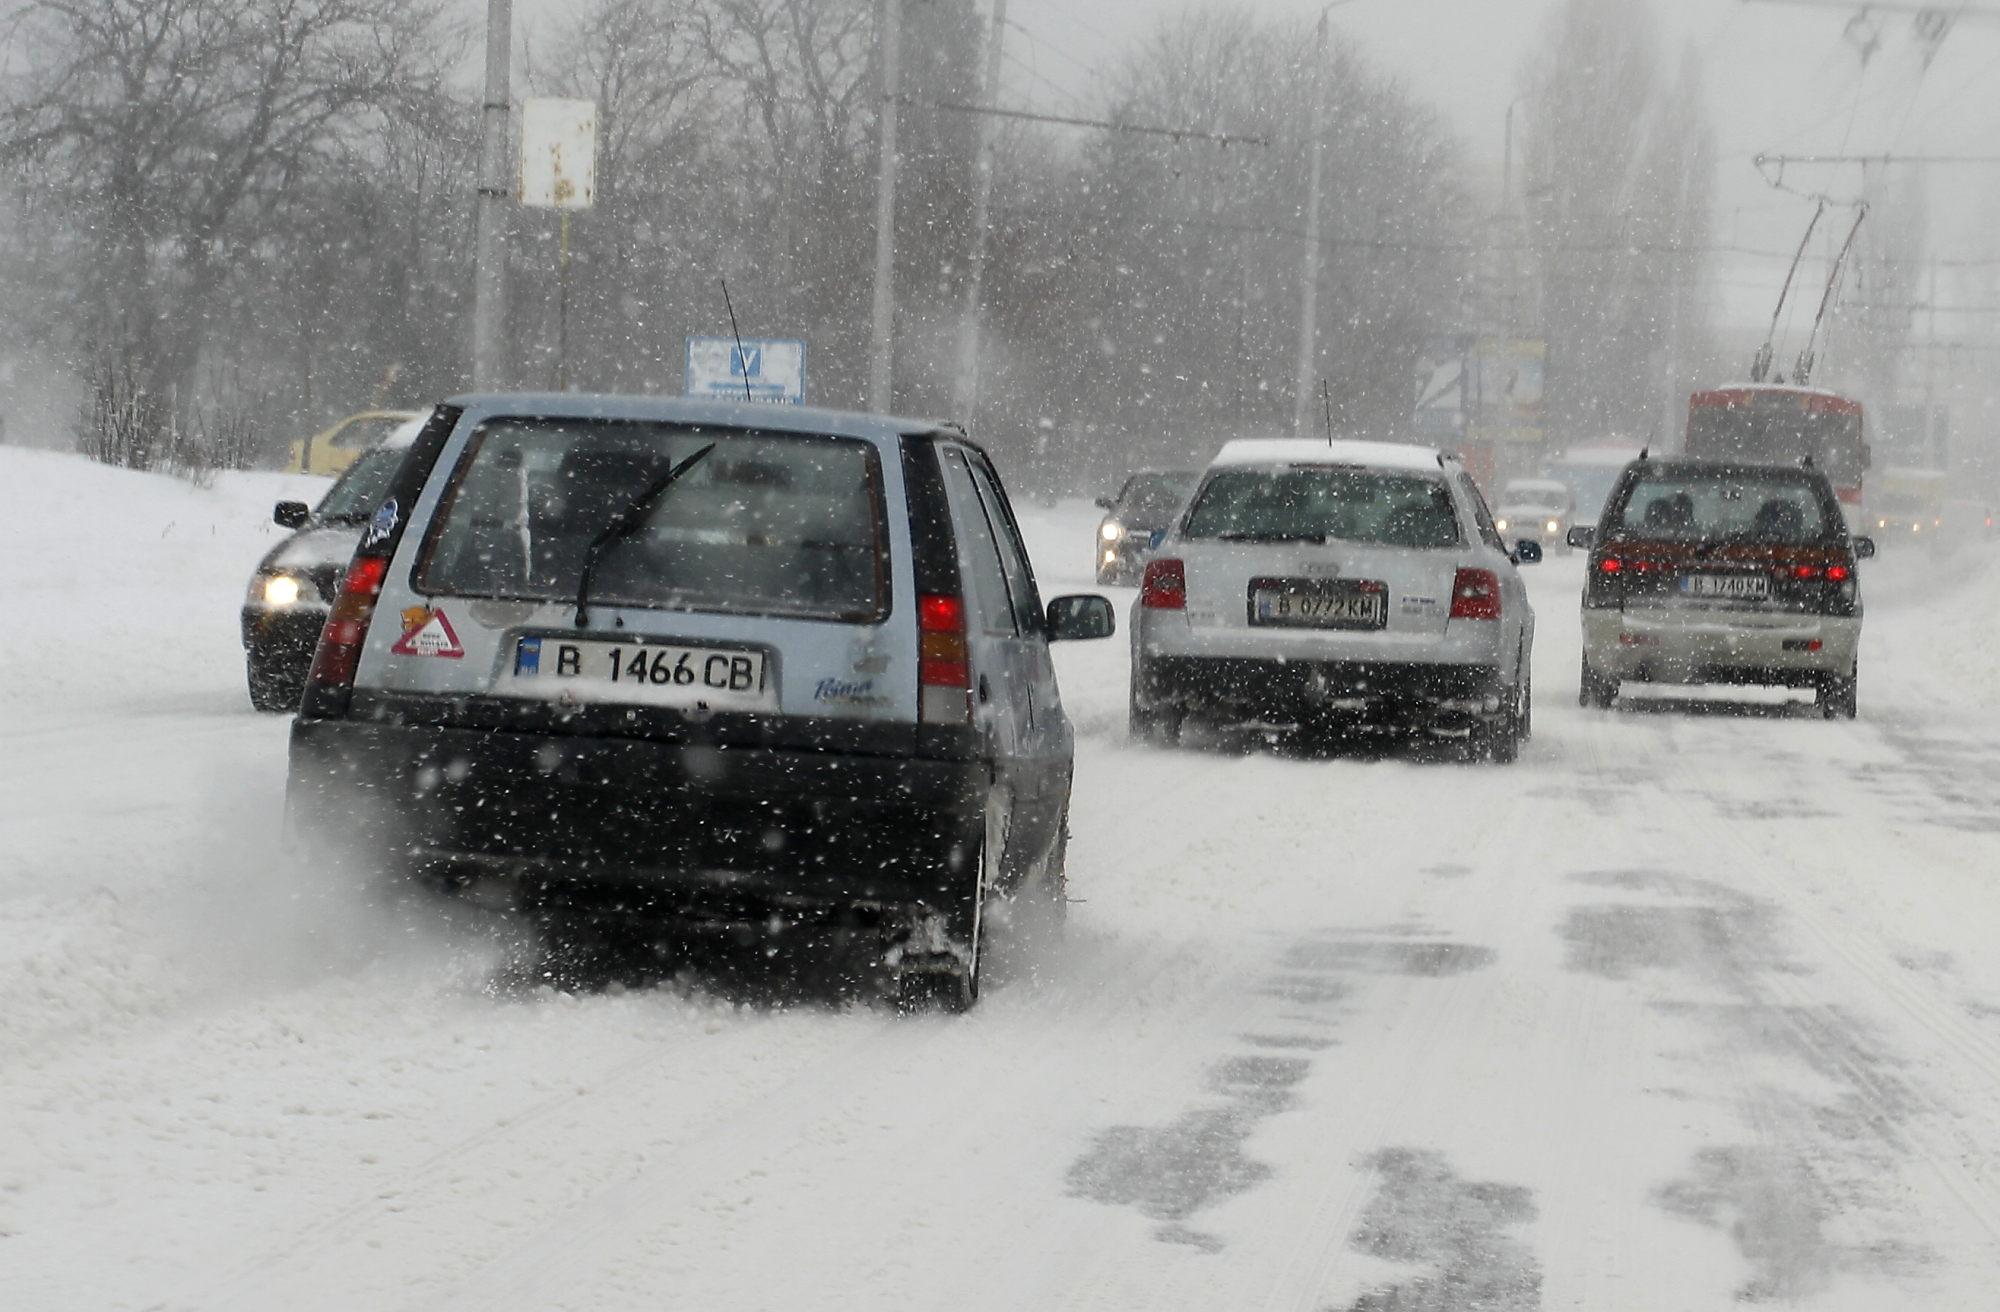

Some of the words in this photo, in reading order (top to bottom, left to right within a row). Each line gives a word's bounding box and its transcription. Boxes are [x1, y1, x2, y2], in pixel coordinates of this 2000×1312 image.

[557, 645, 581, 676] B
[608, 647, 695, 685] 1466
[704, 653, 753, 691] CB
